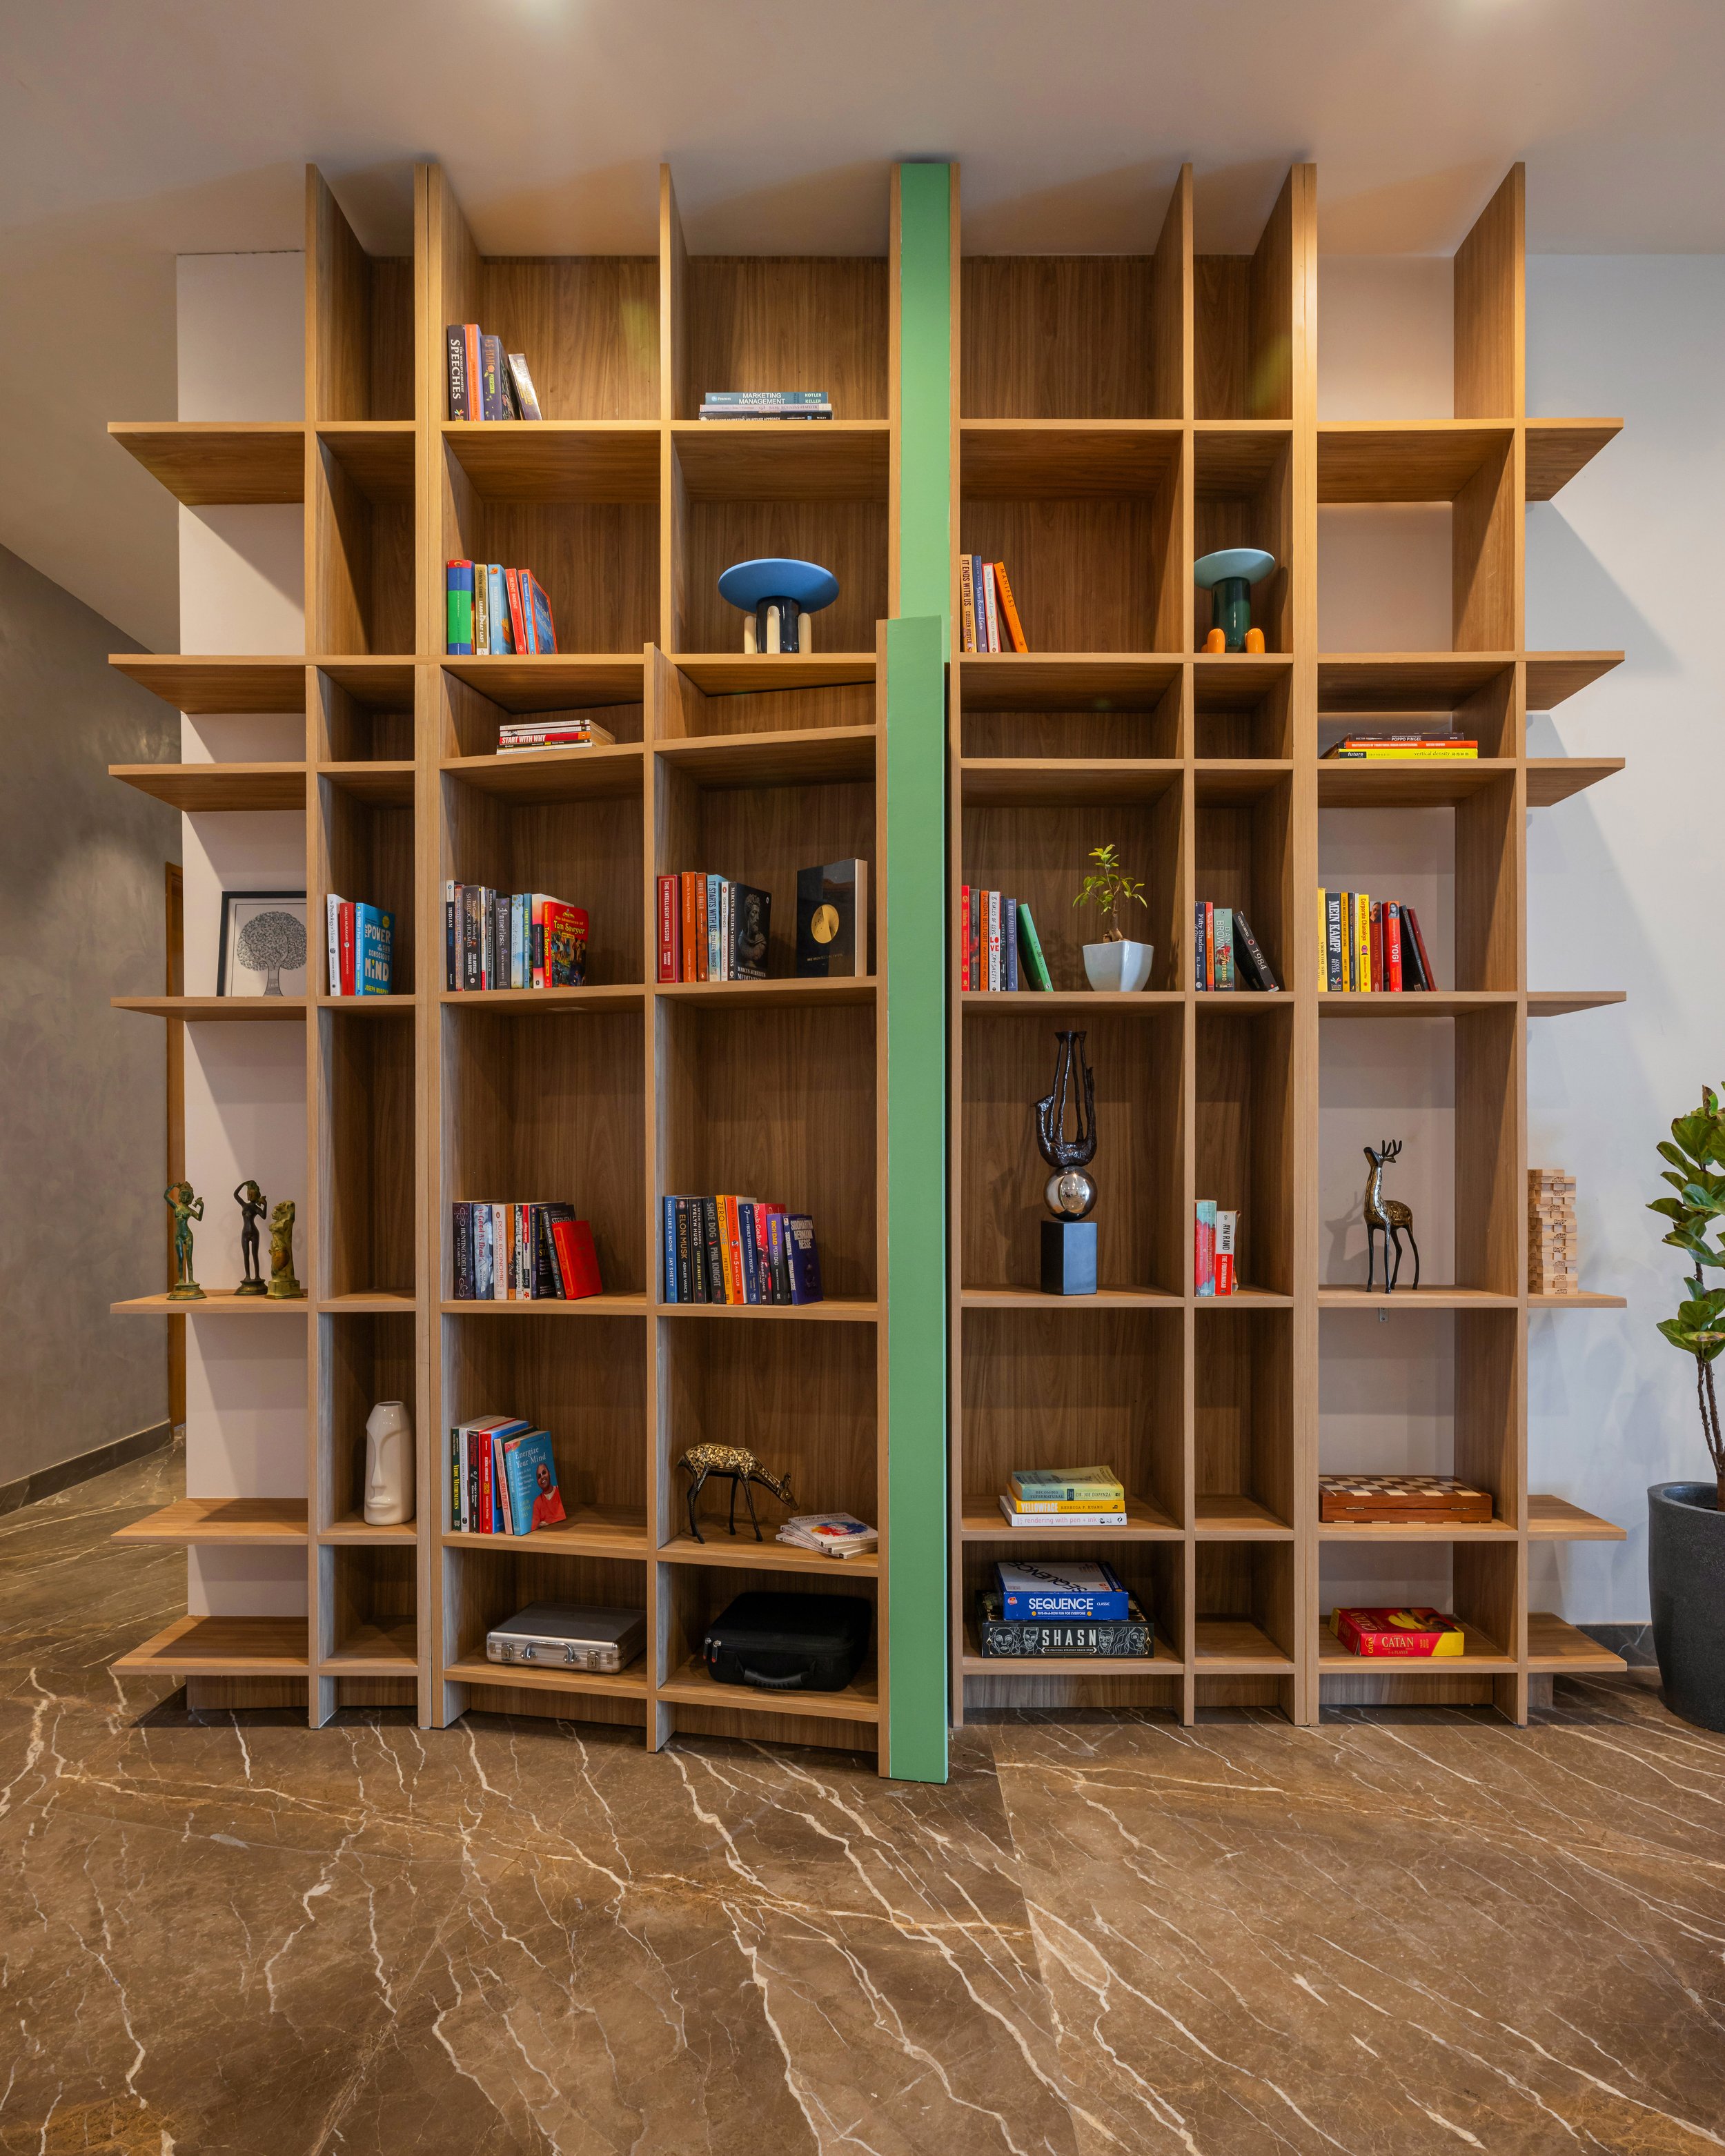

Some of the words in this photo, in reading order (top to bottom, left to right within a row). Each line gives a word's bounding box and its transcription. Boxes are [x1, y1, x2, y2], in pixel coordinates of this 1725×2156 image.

[451, 339, 460, 399] SPEECHES
[1000, 568, 1014, 608] MANIFEST
[1329, 901, 1340, 922] MEIN
[368, 924, 391, 944] POWER
[553, 920, 564, 930] Tom
[565, 922, 585, 934] Sawyer
[1216, 920, 1225, 949] BROWN
[1330, 924, 1340, 953] KAMPF
[1252, 947, 1267, 970] 1984
[707, 1203, 715, 1220] SHOE
[712, 1263, 720, 1286] KNIGHT
[515, 1447, 539, 1459] Energize
[531, 1452, 546, 1463] Mind
[1021, 1503, 1058, 1512] YELLOWFACE
[1029, 1599, 1094, 1610] SEQUENCE
[1043, 1630, 1096, 1645] SHASN
[1381, 1636, 1414, 1648] CATAN
